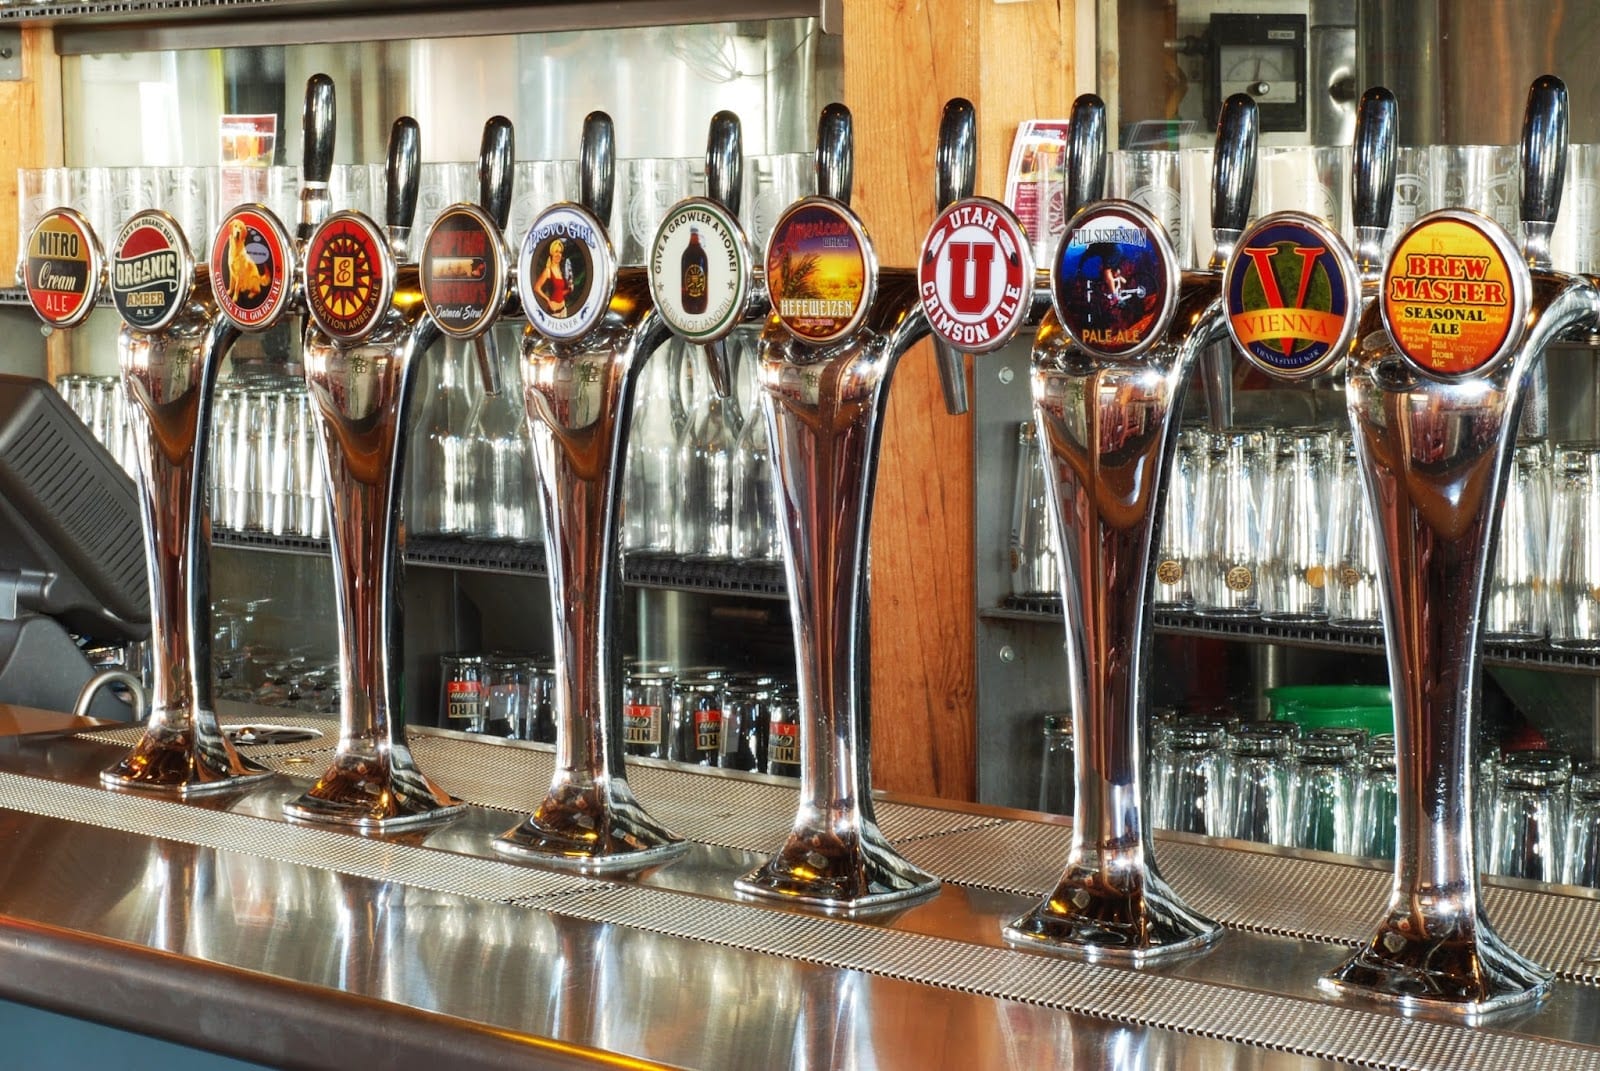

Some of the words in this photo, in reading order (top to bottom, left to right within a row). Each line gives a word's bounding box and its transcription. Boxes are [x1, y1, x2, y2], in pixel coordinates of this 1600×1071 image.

[949, 207, 998, 231] UTAH
[39, 231, 79, 257] NITRO
[529, 222, 566, 254] PROVO
[567, 221, 596, 249] GIRL
[655, 245, 664, 274] GIVE
[662, 234, 669, 243] A
[668, 212, 711, 233] GROWLER
[712, 222, 719, 232] A
[1072, 229, 1095, 247] FULL
[1095, 227, 1147, 248] SUSPENSION
[38, 261, 76, 290] Cream
[116, 253, 176, 287] ORGANIC
[948, 242, 995, 315] U
[1408, 255, 1490, 280] BREW
[46, 294, 68, 312] ALE
[126, 291, 165, 307] AMBER
[214, 271, 233, 311] CHASING
[233, 307, 248, 320] TAIL
[249, 298, 275, 320] GOLDEN
[272, 279, 281, 296] ALE
[1243, 246, 1326, 357] V
[1392, 278, 1506, 305] MASTER
[136, 308, 154, 317] ALE
[309, 279, 346, 330] EMIGRATION
[348, 306, 373, 329] AMBER
[370, 284, 380, 305] ALE
[780, 299, 853, 317] HEFEWEIZEN
[923, 281, 990, 343] CRIMSON
[994, 284, 1021, 331] ALE
[1404, 306, 1486, 321] SEASONAL
[547, 319, 578, 331] PILSNER
[679, 318, 698, 331] NOT
[1082, 329, 1112, 344] PALE
[1115, 329, 1141, 344] ALE
[1242, 313, 1328, 337] VIENNA
[1430, 323, 1459, 335] ALE
[450, 703, 480, 716] ITRO
